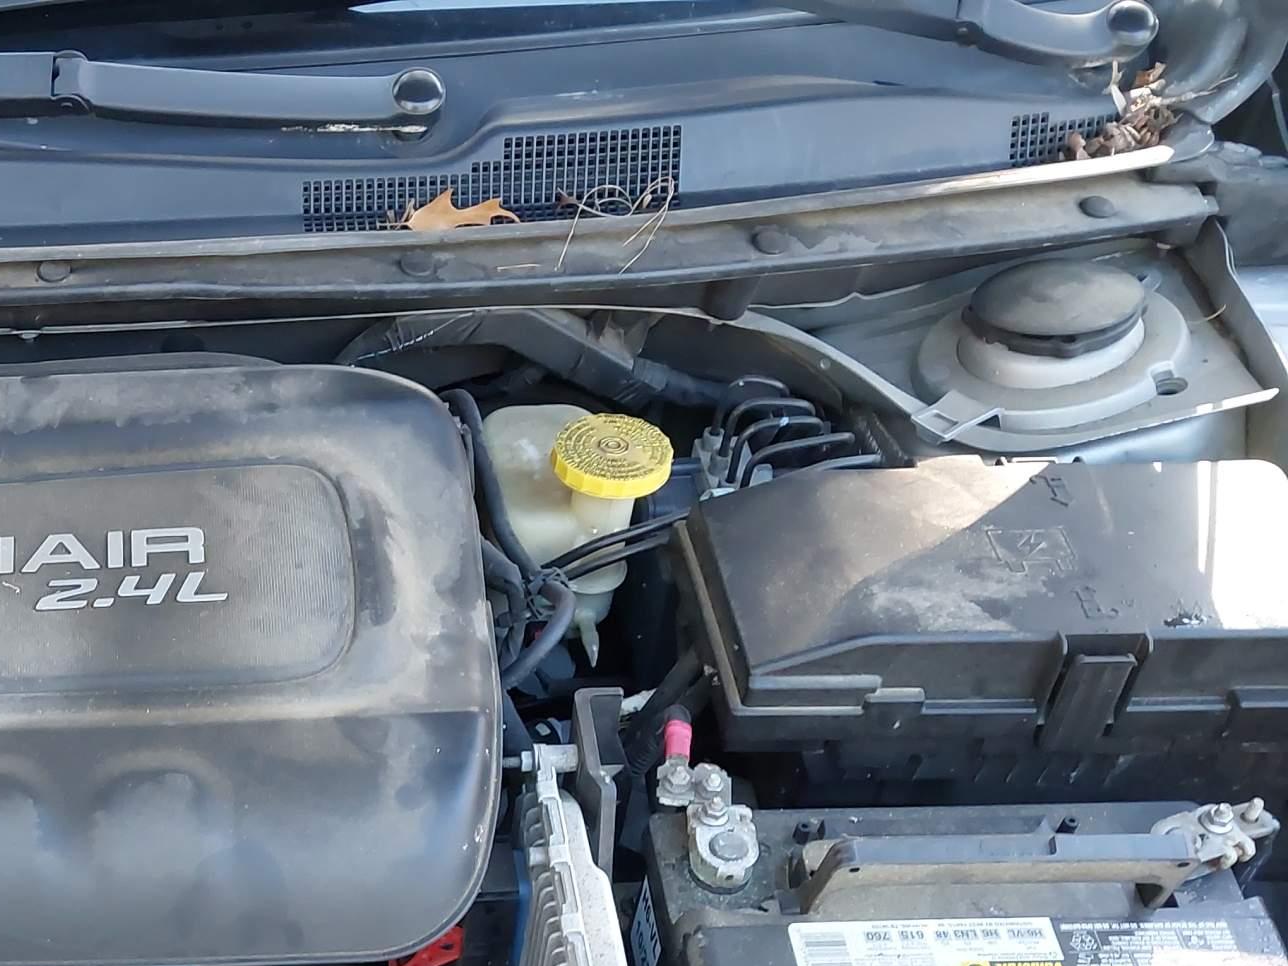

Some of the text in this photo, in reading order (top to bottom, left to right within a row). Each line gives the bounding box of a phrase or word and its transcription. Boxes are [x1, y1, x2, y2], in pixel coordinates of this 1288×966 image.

[34, 571, 228, 610] 2.4L
[866, 931, 890, 941] 760
[901, 930, 924, 940] 615
[935, 929, 950, 939] 48
[953, 928, 978, 939] LN3
[981, 928, 1000, 939] H6
